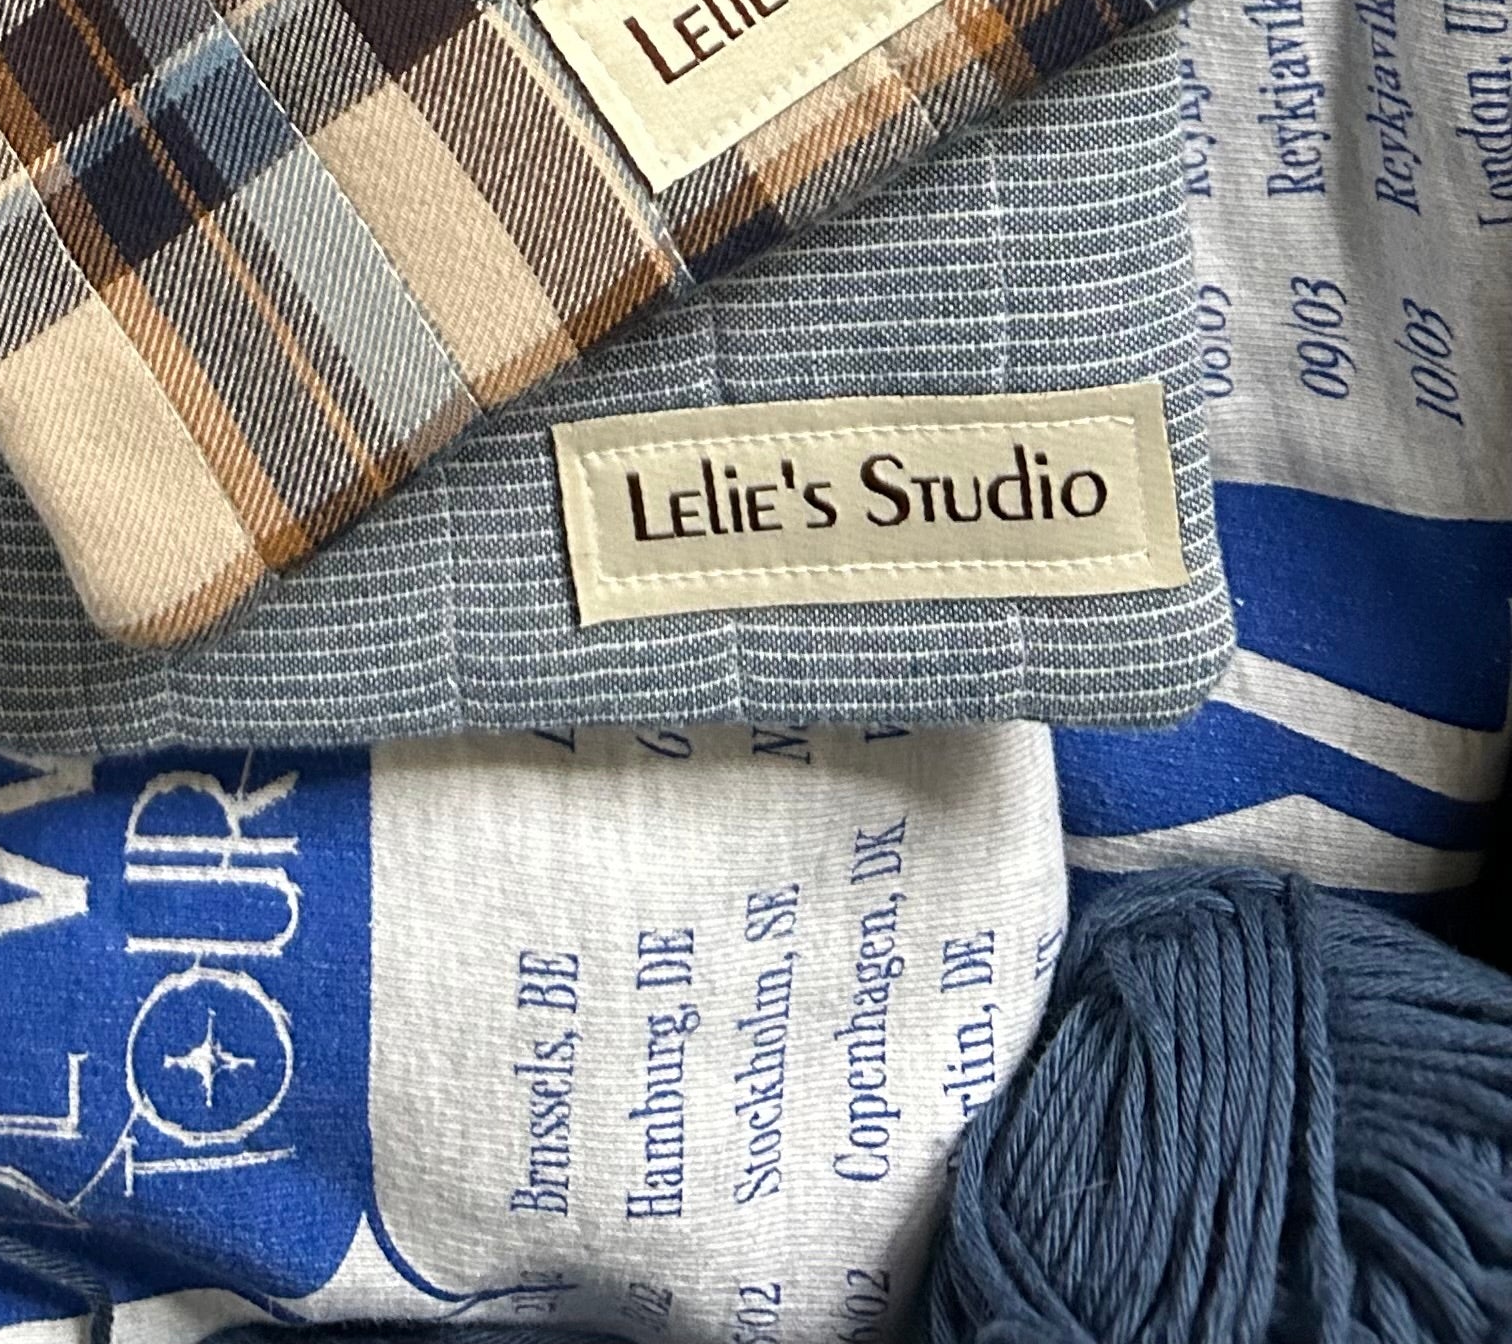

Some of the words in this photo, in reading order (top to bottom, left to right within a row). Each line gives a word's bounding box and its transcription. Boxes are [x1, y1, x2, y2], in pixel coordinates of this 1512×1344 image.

[1283, 277, 1356, 400] 09/03
[1394, 296, 1465, 427] 10/03
[744, 883, 801, 944] SE
[850, 816, 907, 885] DK
[122, 767, 302, 1197] TOUR
[517, 950, 580, 1013] BE
[638, 927, 694, 990] DE
[941, 930, 995, 993] DE
[733, 949, 801, 1205] Stockholm,
[833, 892, 908, 1182] Copenhagen,
[510, 1026, 584, 1217] Brussels,
[627, 1002, 702, 1220] Hamburg,
